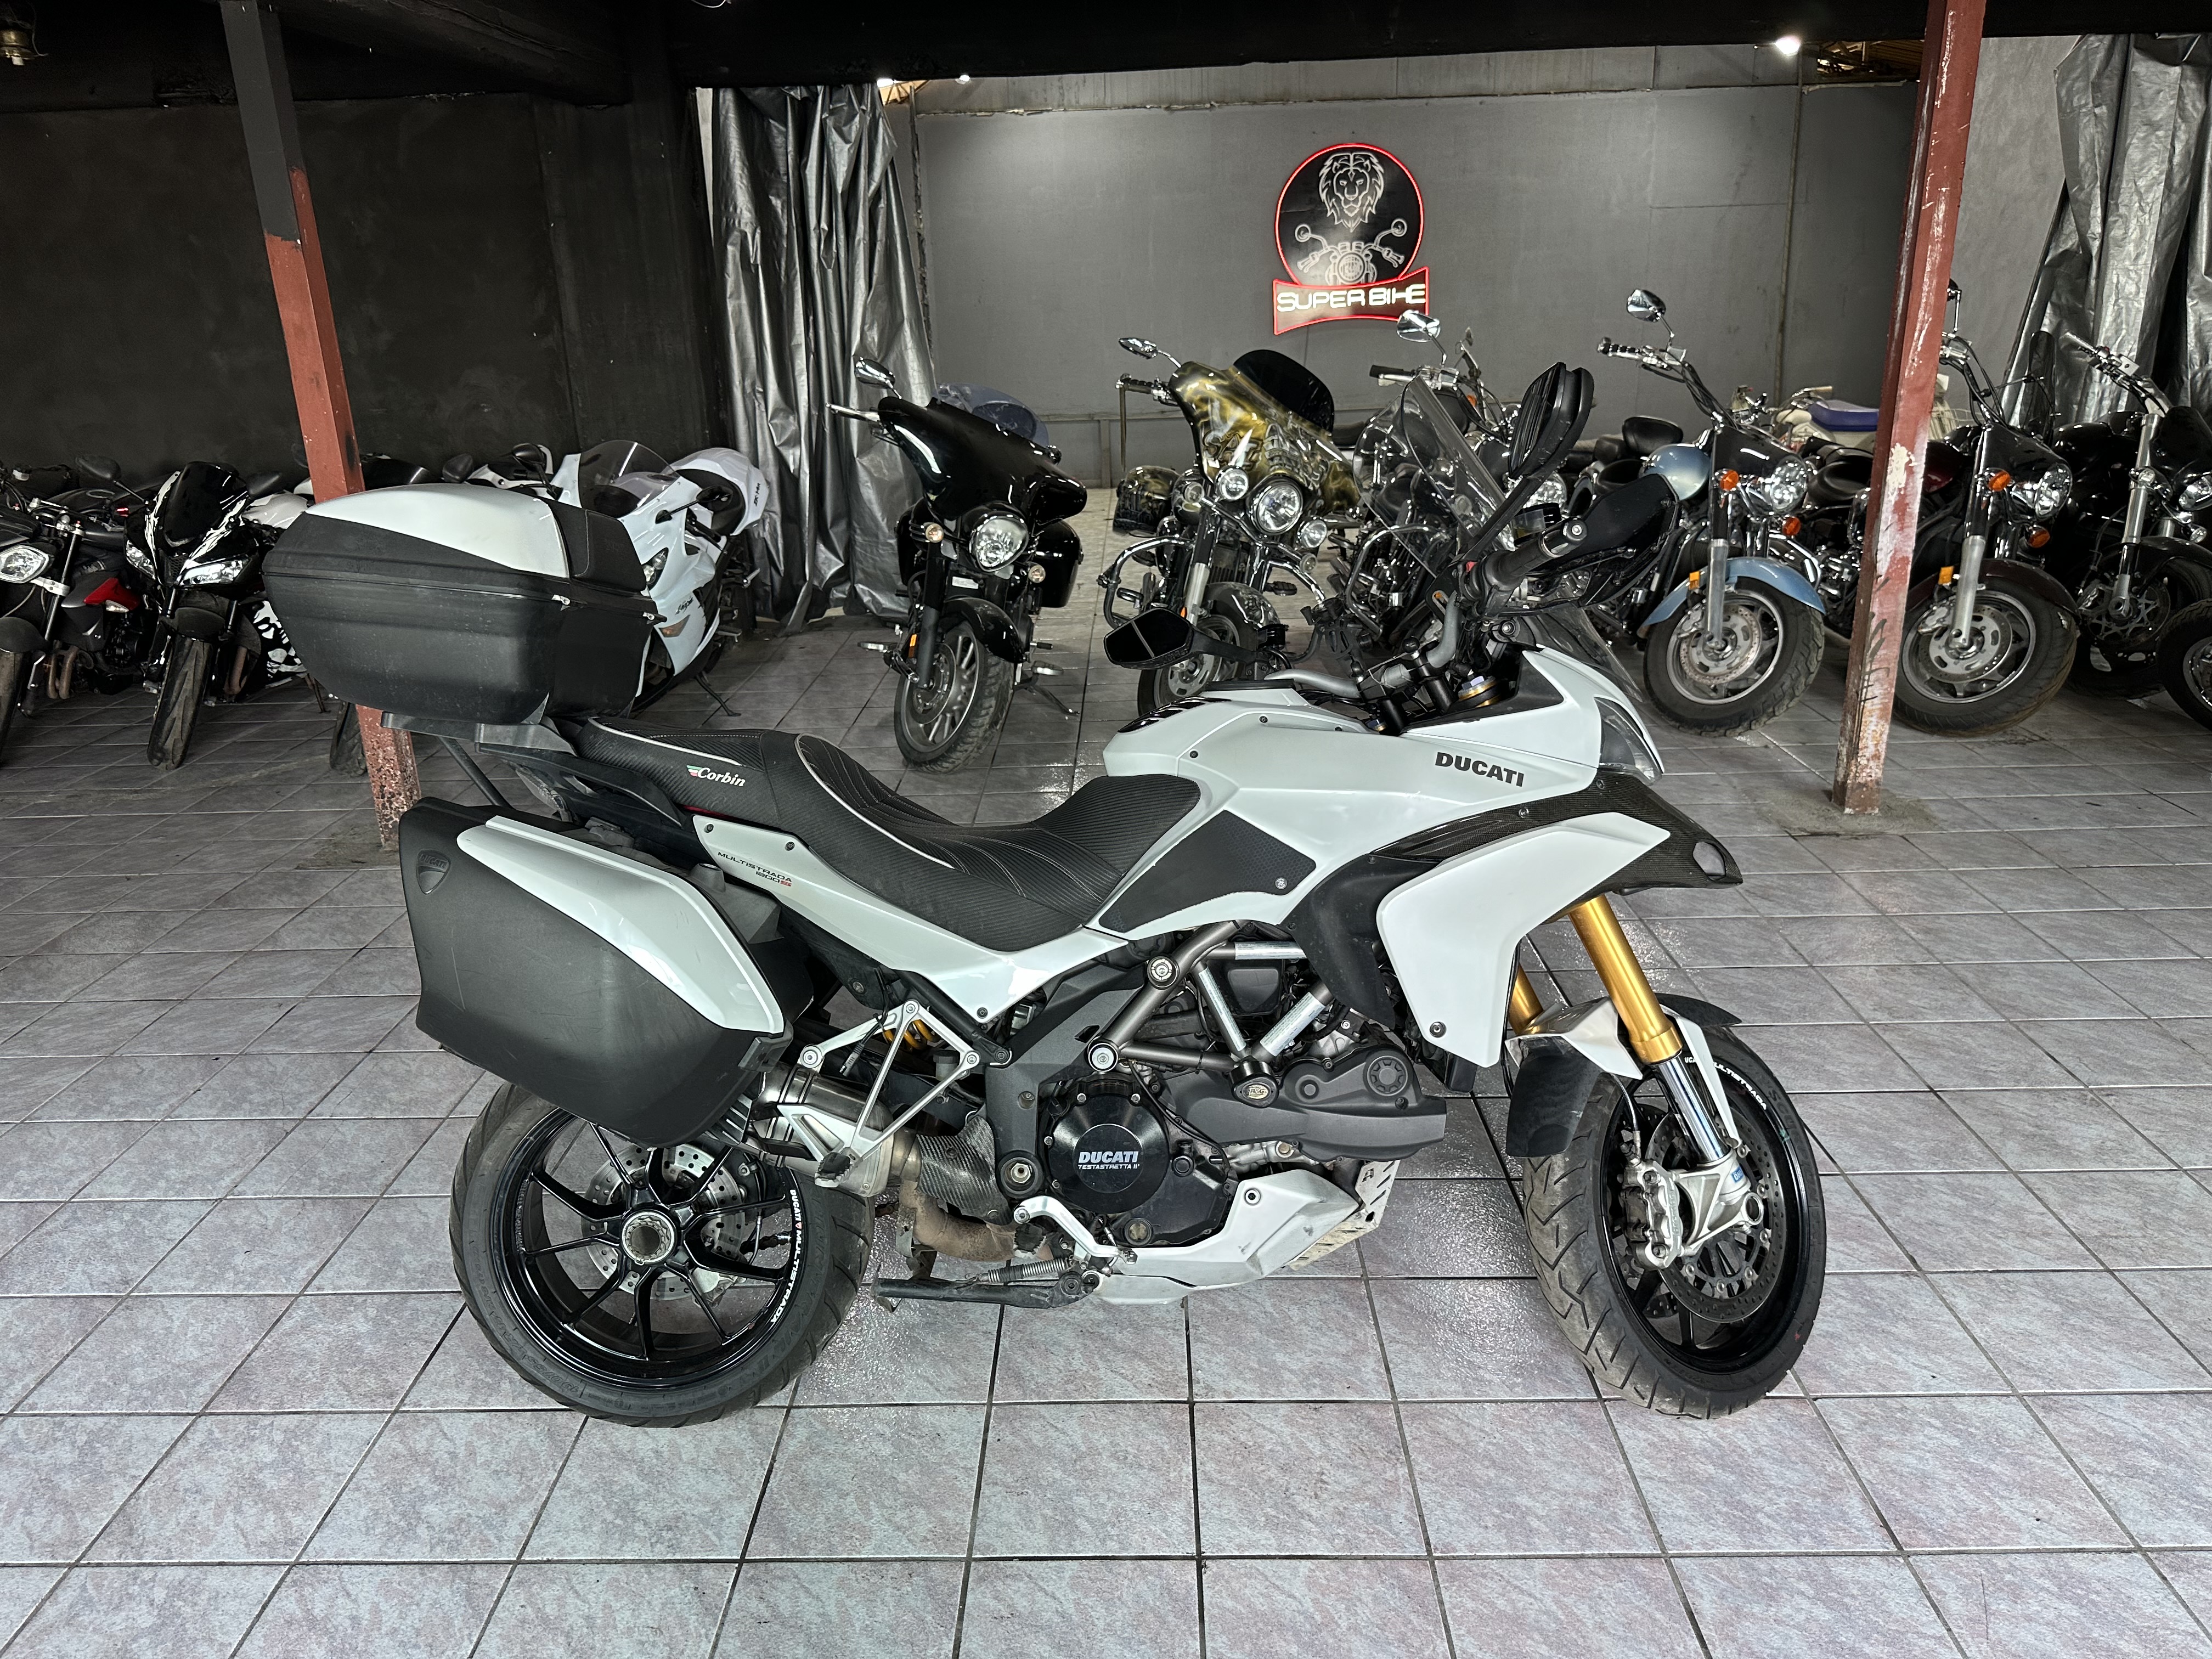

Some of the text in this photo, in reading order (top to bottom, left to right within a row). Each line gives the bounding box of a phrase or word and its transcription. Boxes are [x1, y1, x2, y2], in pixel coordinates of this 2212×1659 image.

[1277, 283, 1426, 312] SUPER BIKE
[697, 766, 746, 787] Corbin
[1435, 752, 1525, 788] DUCATI
[419, 853, 448, 868] DUCATI
[717, 851, 792, 883] MULTISTRADA
[1713, 1061, 1767, 1111] ULTISTRADA
[1078, 1150, 1139, 1164] DUCATI
[770, 1189, 802, 1323] DUCATI MULTISTRADA
